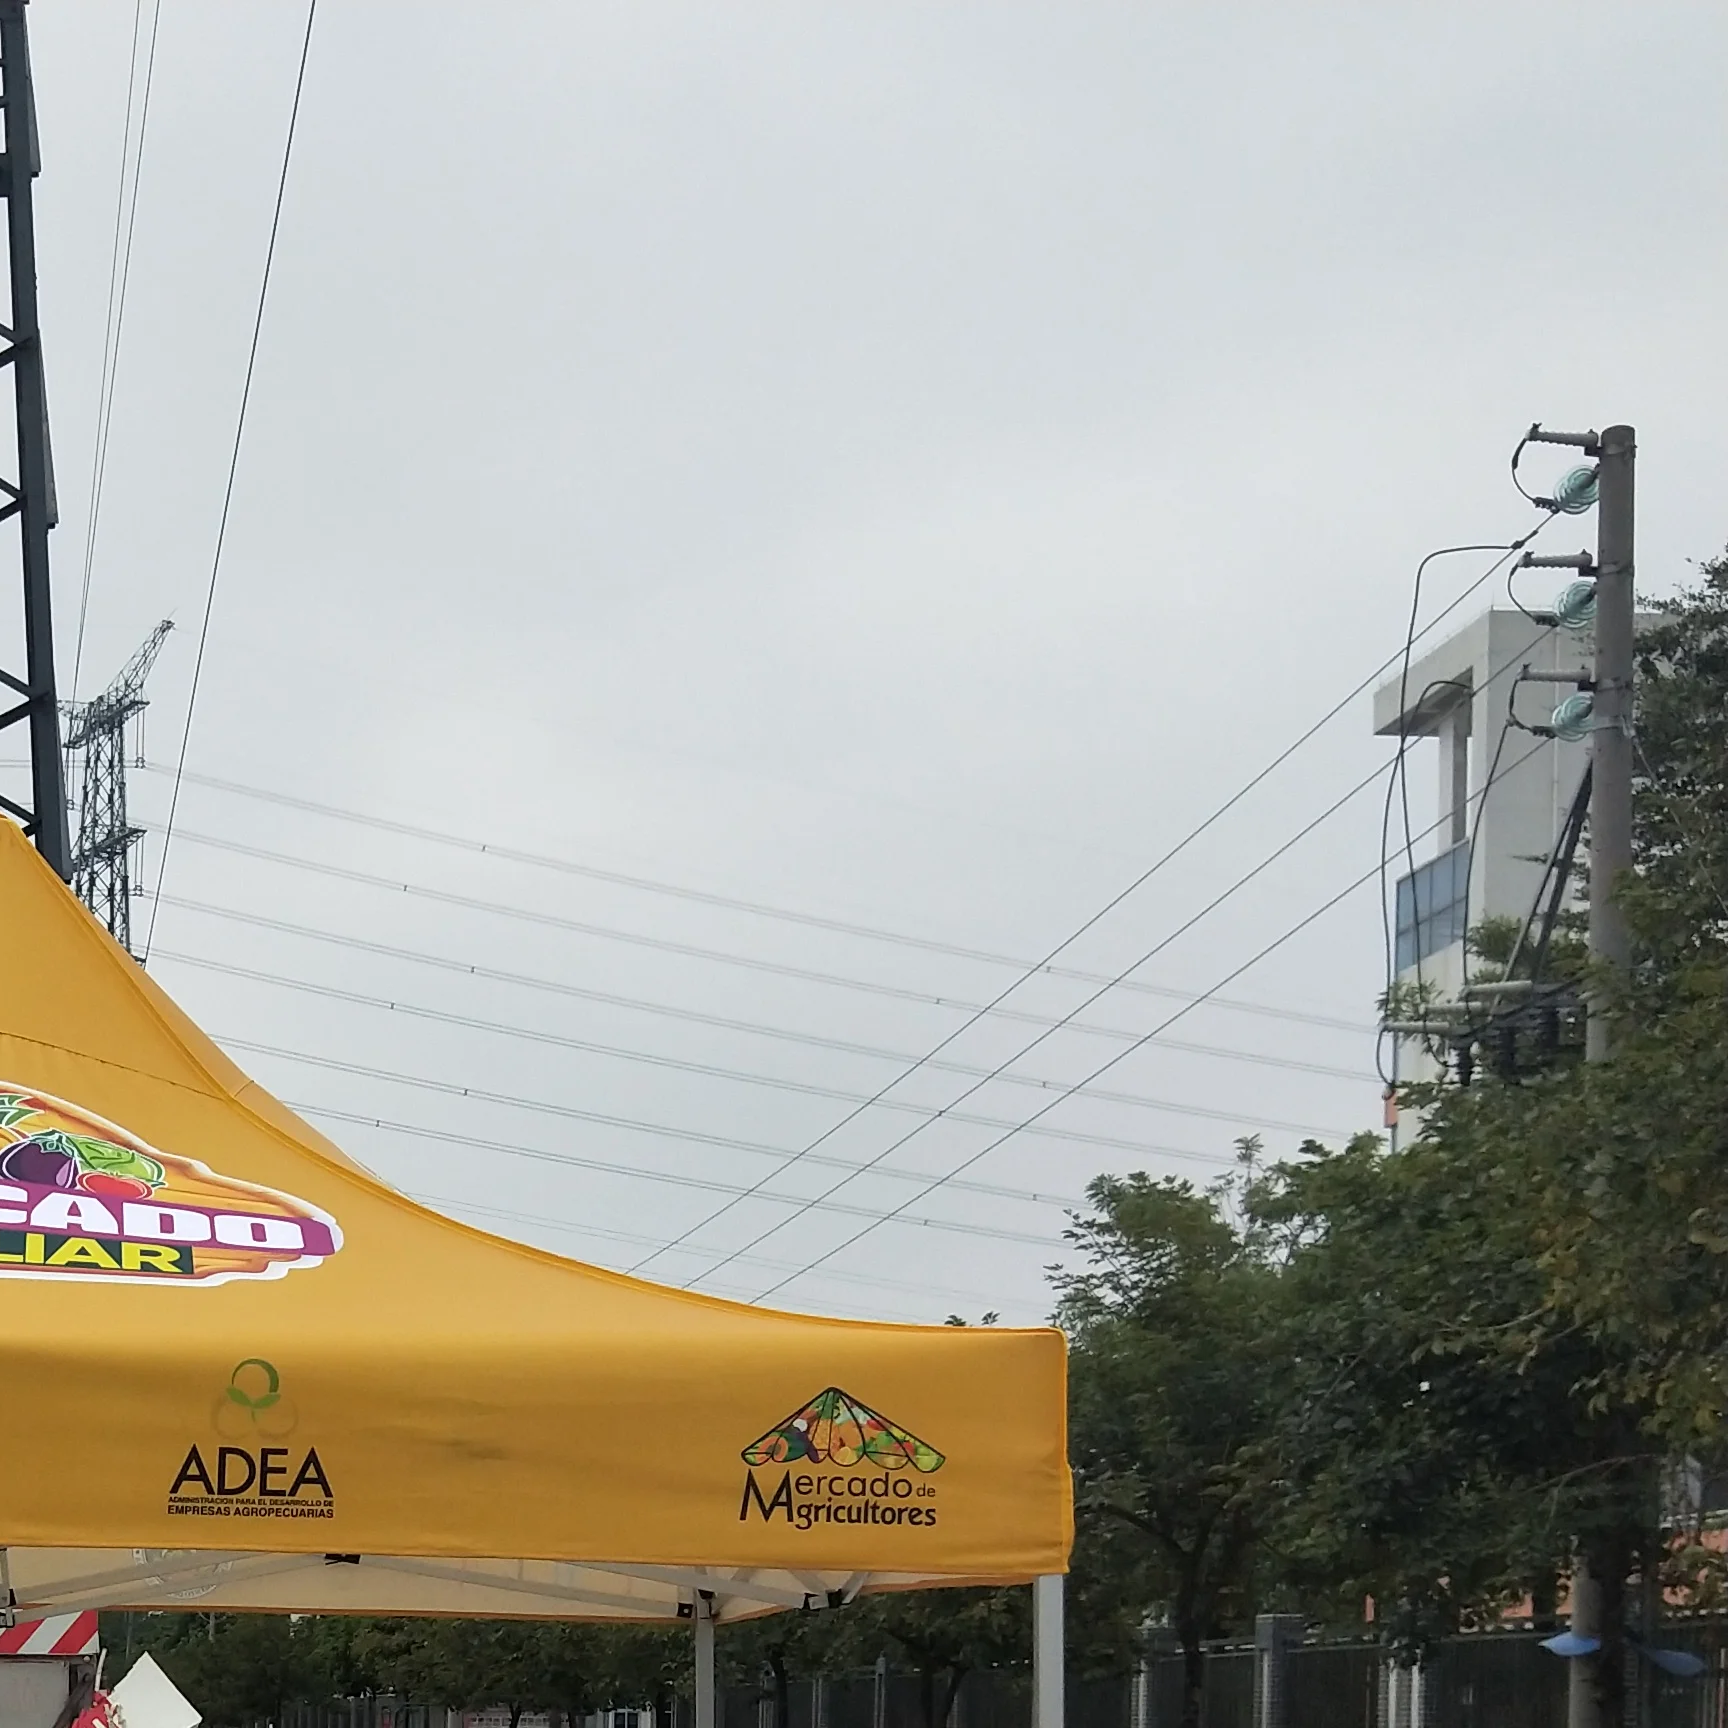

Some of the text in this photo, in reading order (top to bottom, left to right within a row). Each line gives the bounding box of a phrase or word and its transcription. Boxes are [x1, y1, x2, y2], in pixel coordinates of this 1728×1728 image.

[169, 1443, 334, 1498] ADEA
[168, 1505, 334, 1519] EMPRESAS AGROPECUARIAS
[739, 1468, 936, 1523] Mercado de
[770, 1496, 937, 1530] Agricultores
